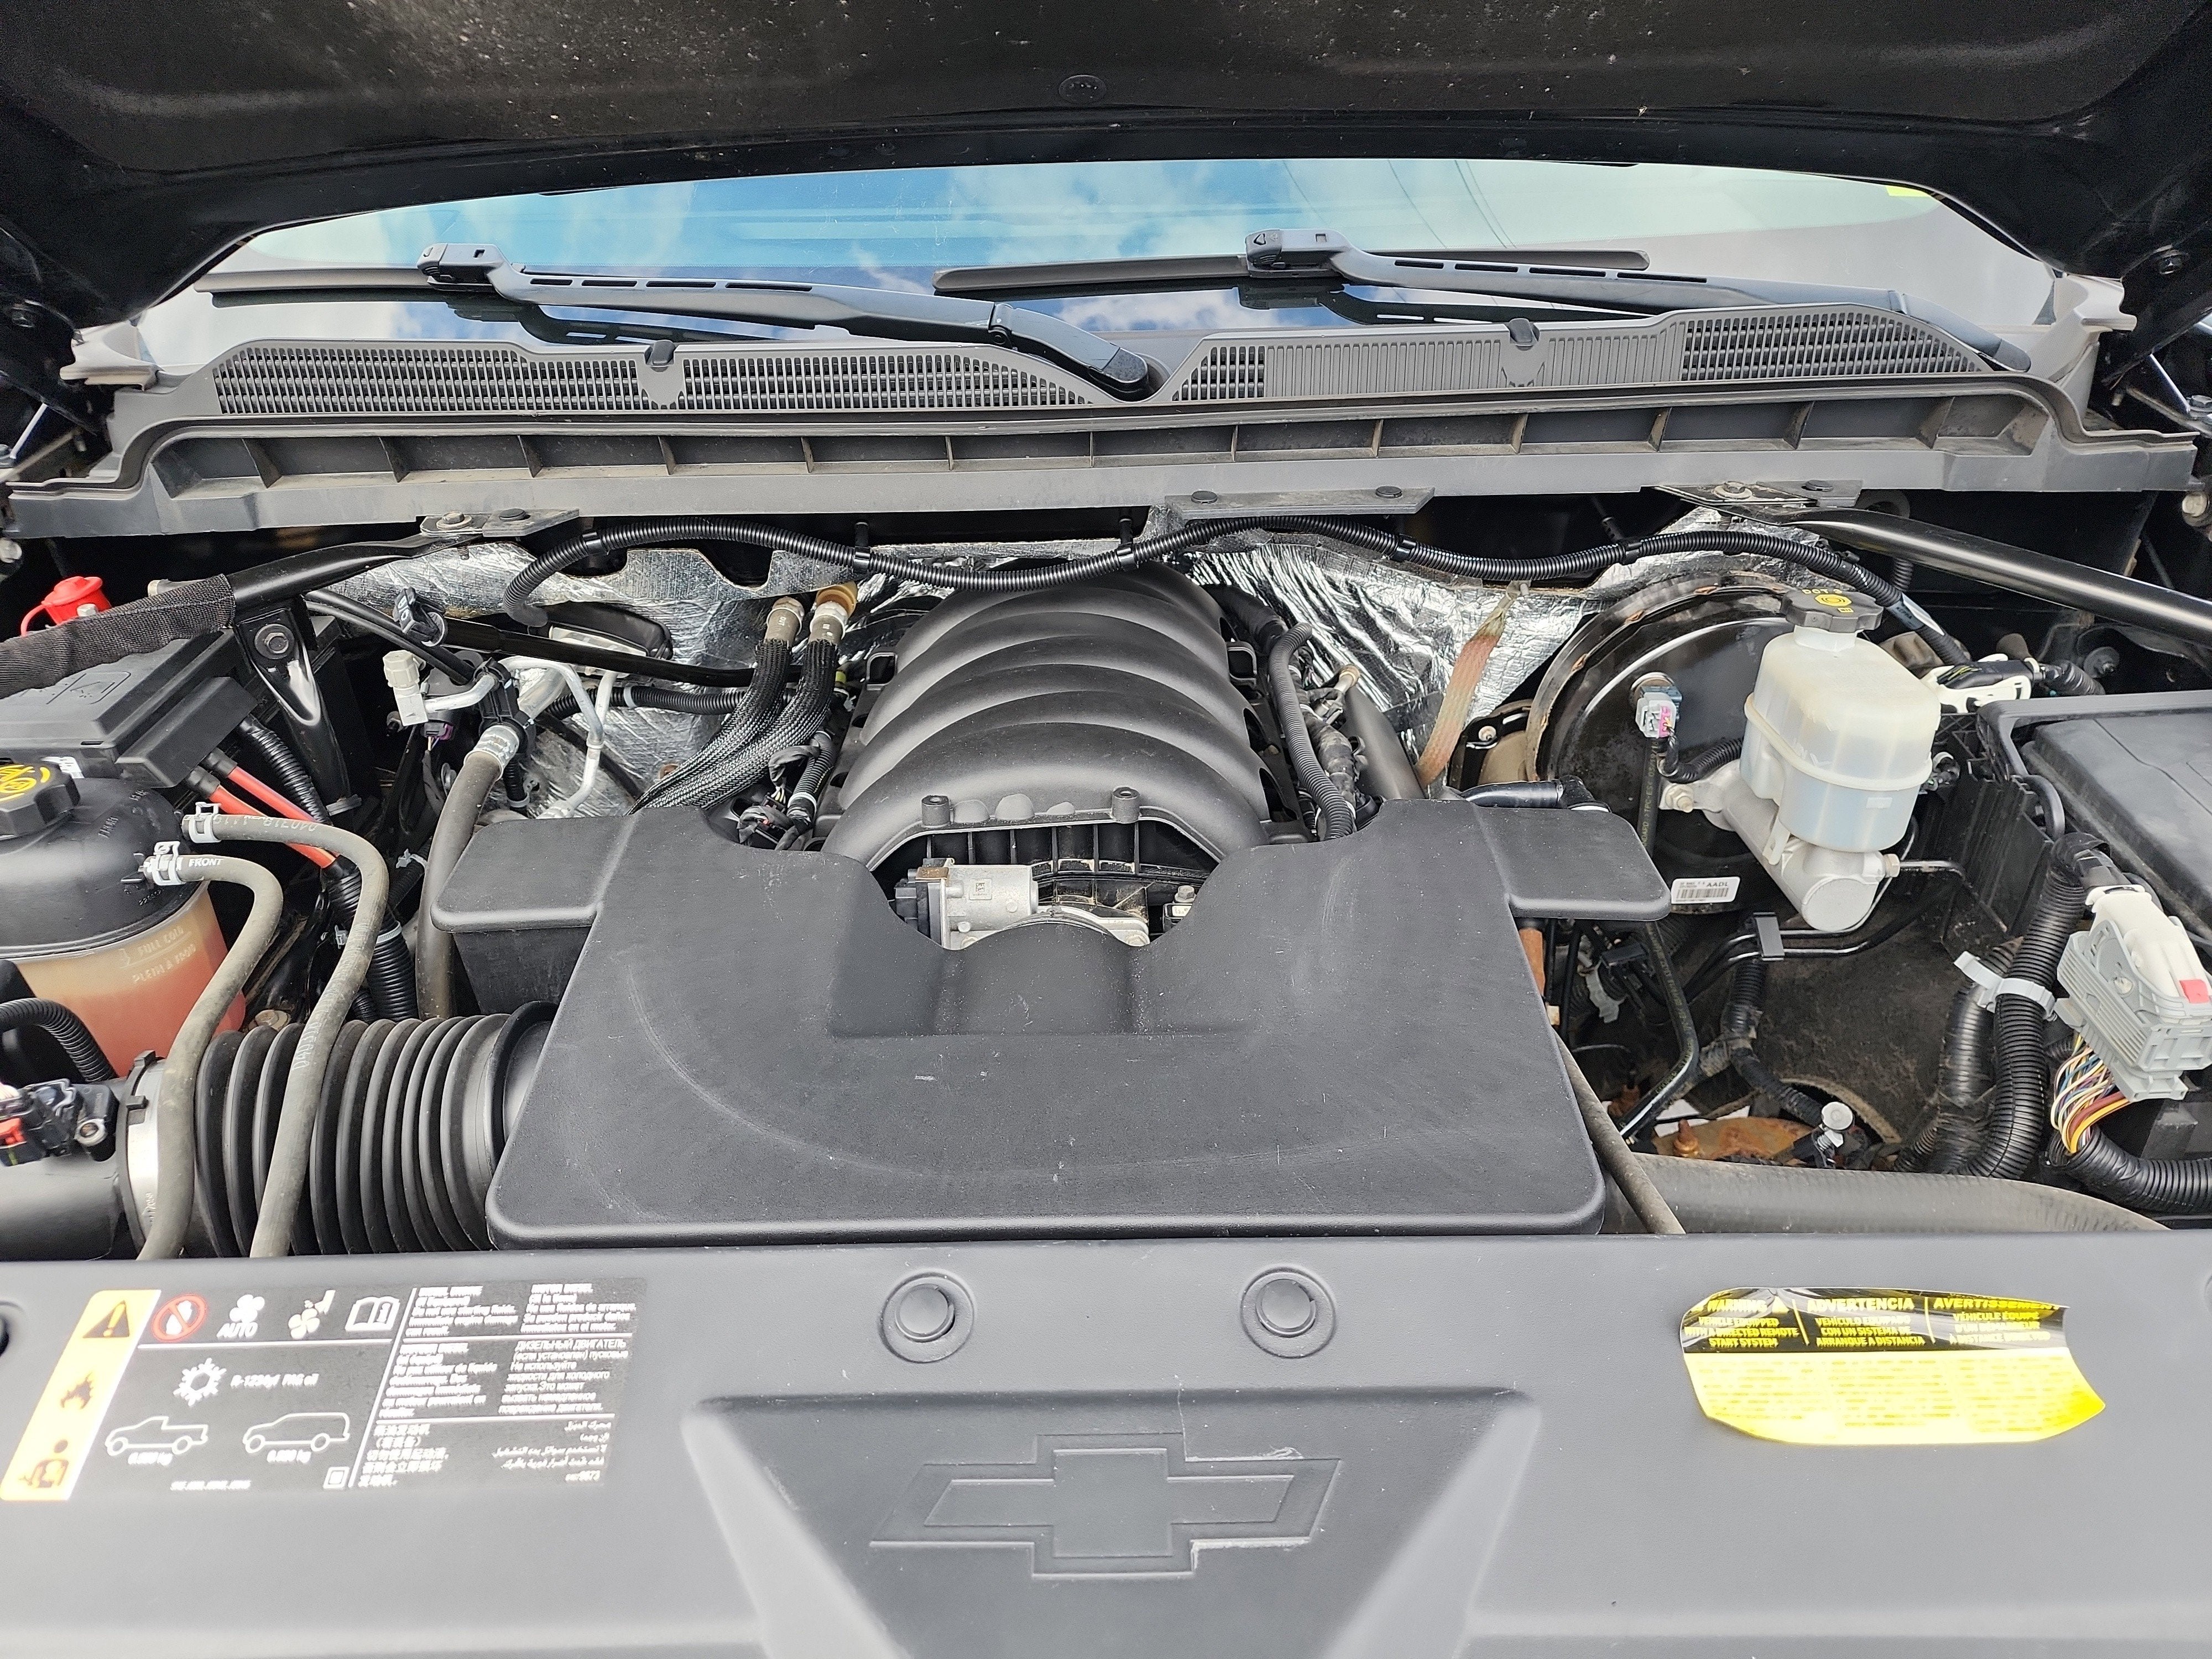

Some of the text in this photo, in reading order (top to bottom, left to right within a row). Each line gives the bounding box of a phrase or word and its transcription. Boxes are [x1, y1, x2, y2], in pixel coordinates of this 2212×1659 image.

[189, 858, 224, 867] FRONT
[1708, 1299, 1768, 1312] WARNING
[1807, 1298, 1914, 1312] ADVERTENCIA
[1953, 1312, 2001, 1321] VÉHICULE
[1699, 1317, 1780, 1327] VEHICLE EQUIPPED
[217, 1322, 258, 1338] AUTO
[1760, 1328, 1800, 1337] REMOTE
[1820, 1328, 1844, 1337] CON
[1845, 1328, 1857, 1337] UN
[1857, 1327, 1897, 1336] SISTEMA
[1709, 1338, 1779, 1348] START SYSTEM
[1817, 1337, 1867, 1347] ARRANQUE
[1877, 1336, 1926, 1346] DISTANCIA
